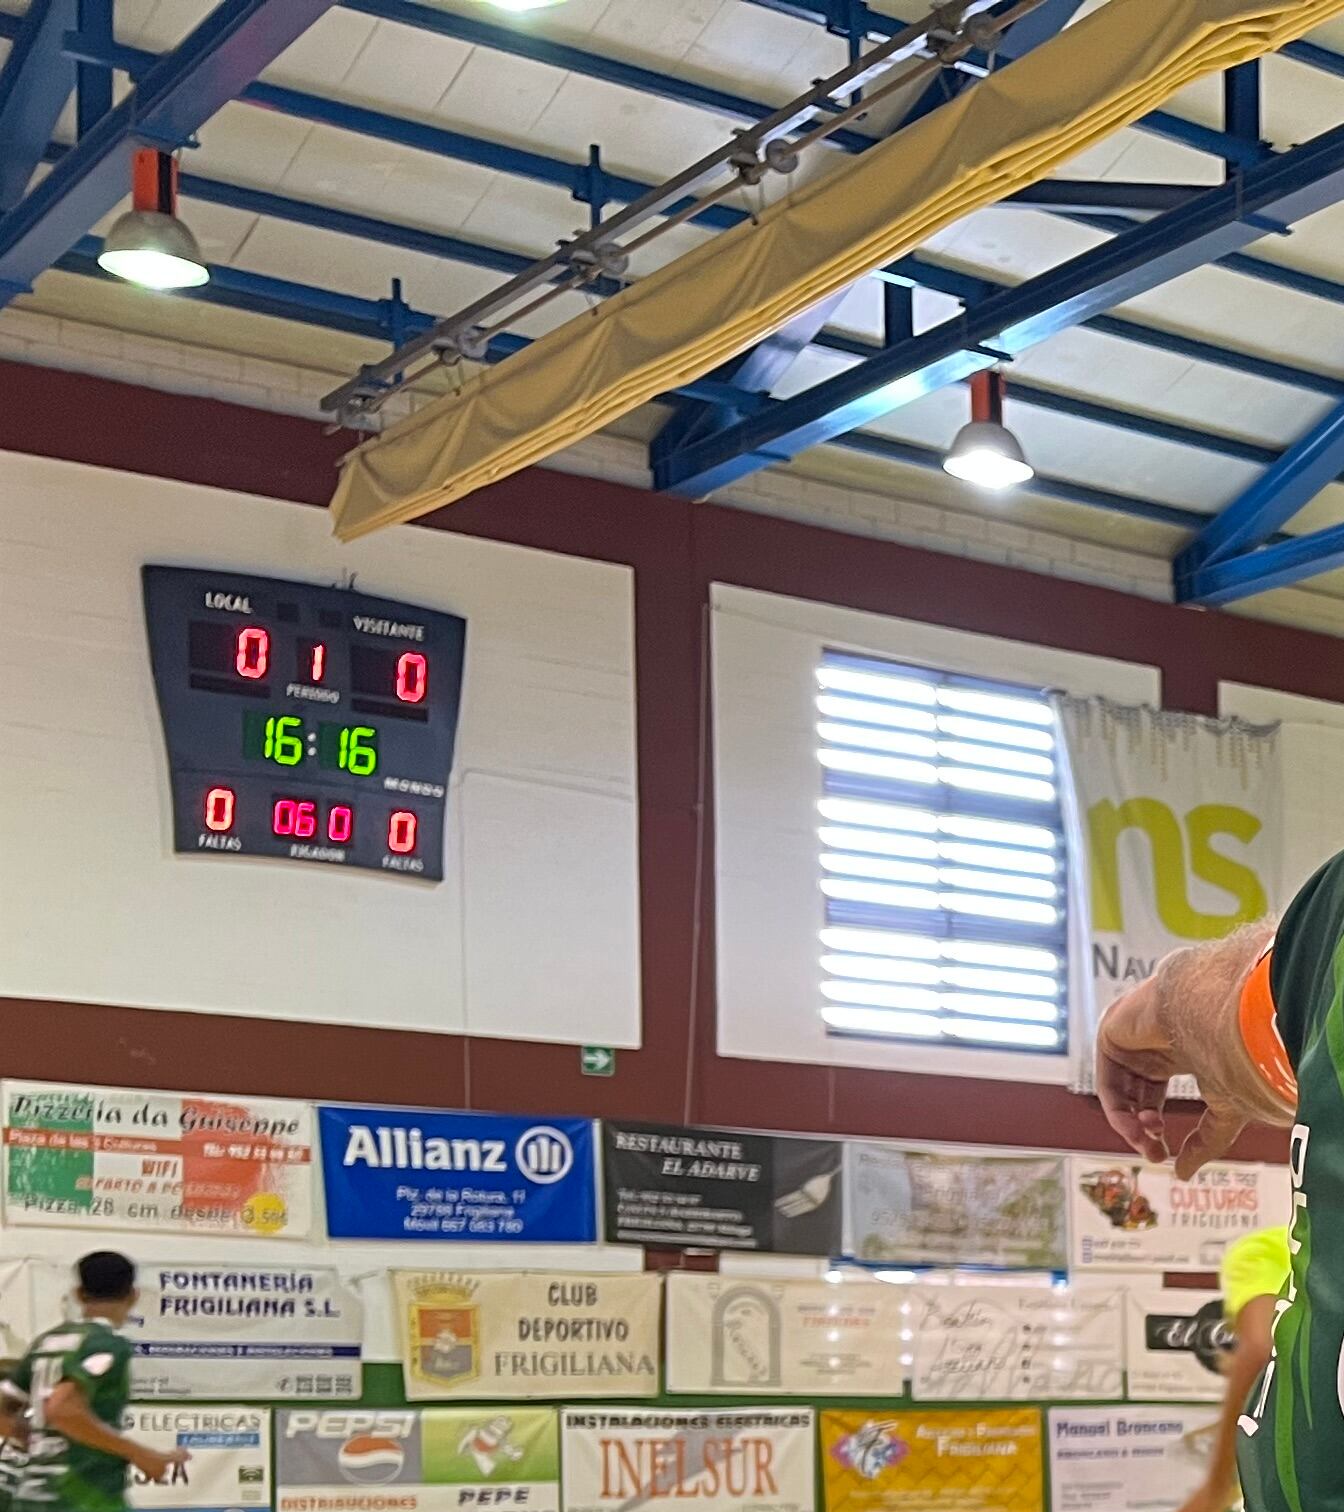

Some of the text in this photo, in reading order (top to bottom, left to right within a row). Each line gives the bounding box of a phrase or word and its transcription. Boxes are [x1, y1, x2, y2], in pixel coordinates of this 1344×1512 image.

[205, 591, 253, 614] LOCAL
[236, 627, 428, 703] 0 1 0
[205, 787, 236, 832] 0
[388, 811, 417, 853] 0
[132, 1102, 168, 1127] da
[343, 1125, 507, 1172] Allianz
[615, 1132, 742, 1160] RESTAURANTE
[141, 1160, 178, 1176] WIFI
[661, 1158, 761, 1182] EL ADARVE
[24, 1195, 77, 1214] Pizza
[548, 1282, 598, 1306] CLUB
[159, 1296, 295, 1318] FRIGILIANA
[518, 1318, 629, 1342] DEPORTIVO
[494, 1351, 655, 1377] FRIGILIANA
[286, 1410, 416, 1439] PEPSI
[599, 1436, 779, 1499] INELSUR
[458, 1487, 530, 1506] PEPE
